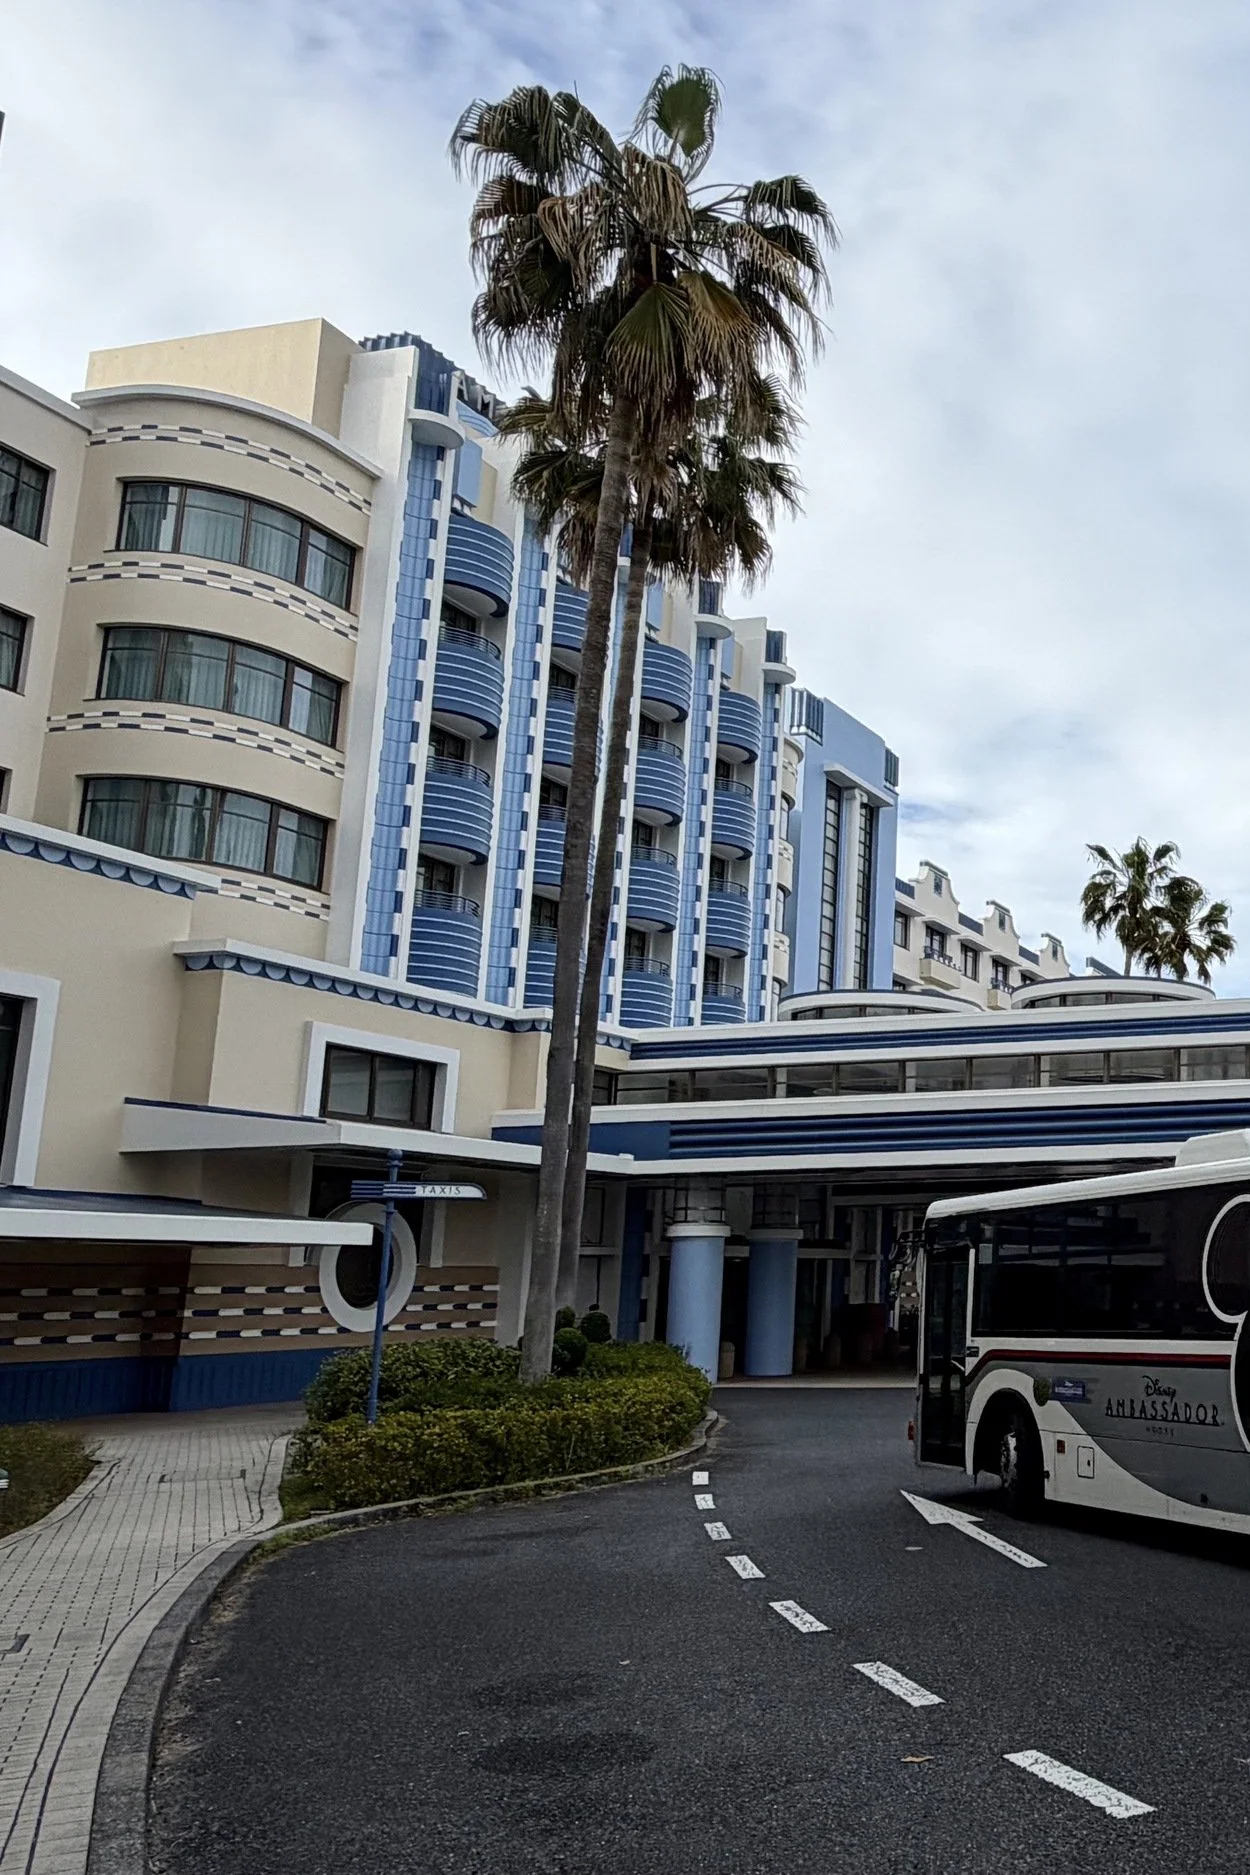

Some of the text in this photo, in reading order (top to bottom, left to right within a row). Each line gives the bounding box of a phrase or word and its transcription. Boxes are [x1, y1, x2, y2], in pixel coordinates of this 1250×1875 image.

[452, 371, 499, 419] AM
[421, 1186, 461, 1195] TAXIS
[1142, 1375, 1176, 1402] Disney
[1105, 1398, 1220, 1427] AMBASSADOR
